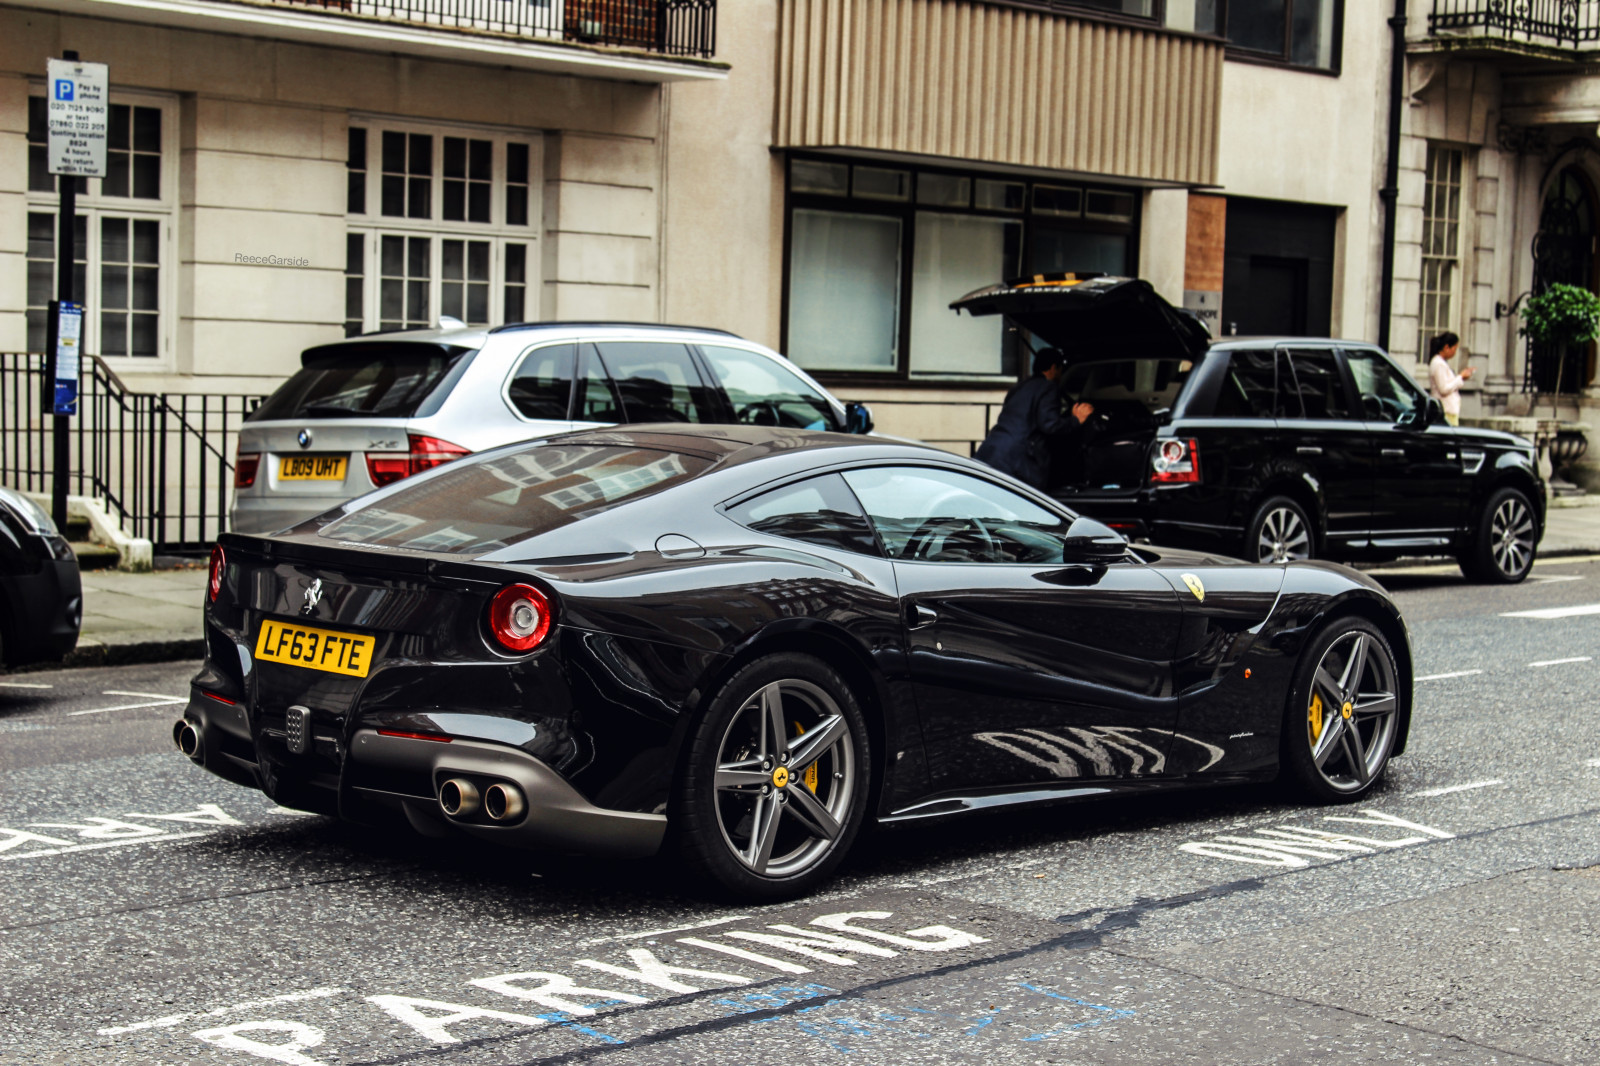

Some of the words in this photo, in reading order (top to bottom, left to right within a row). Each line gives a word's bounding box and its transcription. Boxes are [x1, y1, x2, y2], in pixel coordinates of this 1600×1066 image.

[60, 82, 71, 98] P
[78, 83, 91, 92] Pay
[92, 85, 101, 93] by
[50, 102, 66, 110] 020
[72, 148, 91, 156] hours
[316, 458, 341, 476] UHT
[263, 625, 319, 662] LF63
[320, 635, 365, 670] FTE
[1178, 810, 1456, 868] ONLY
[193, 911, 990, 1066] PARKING
